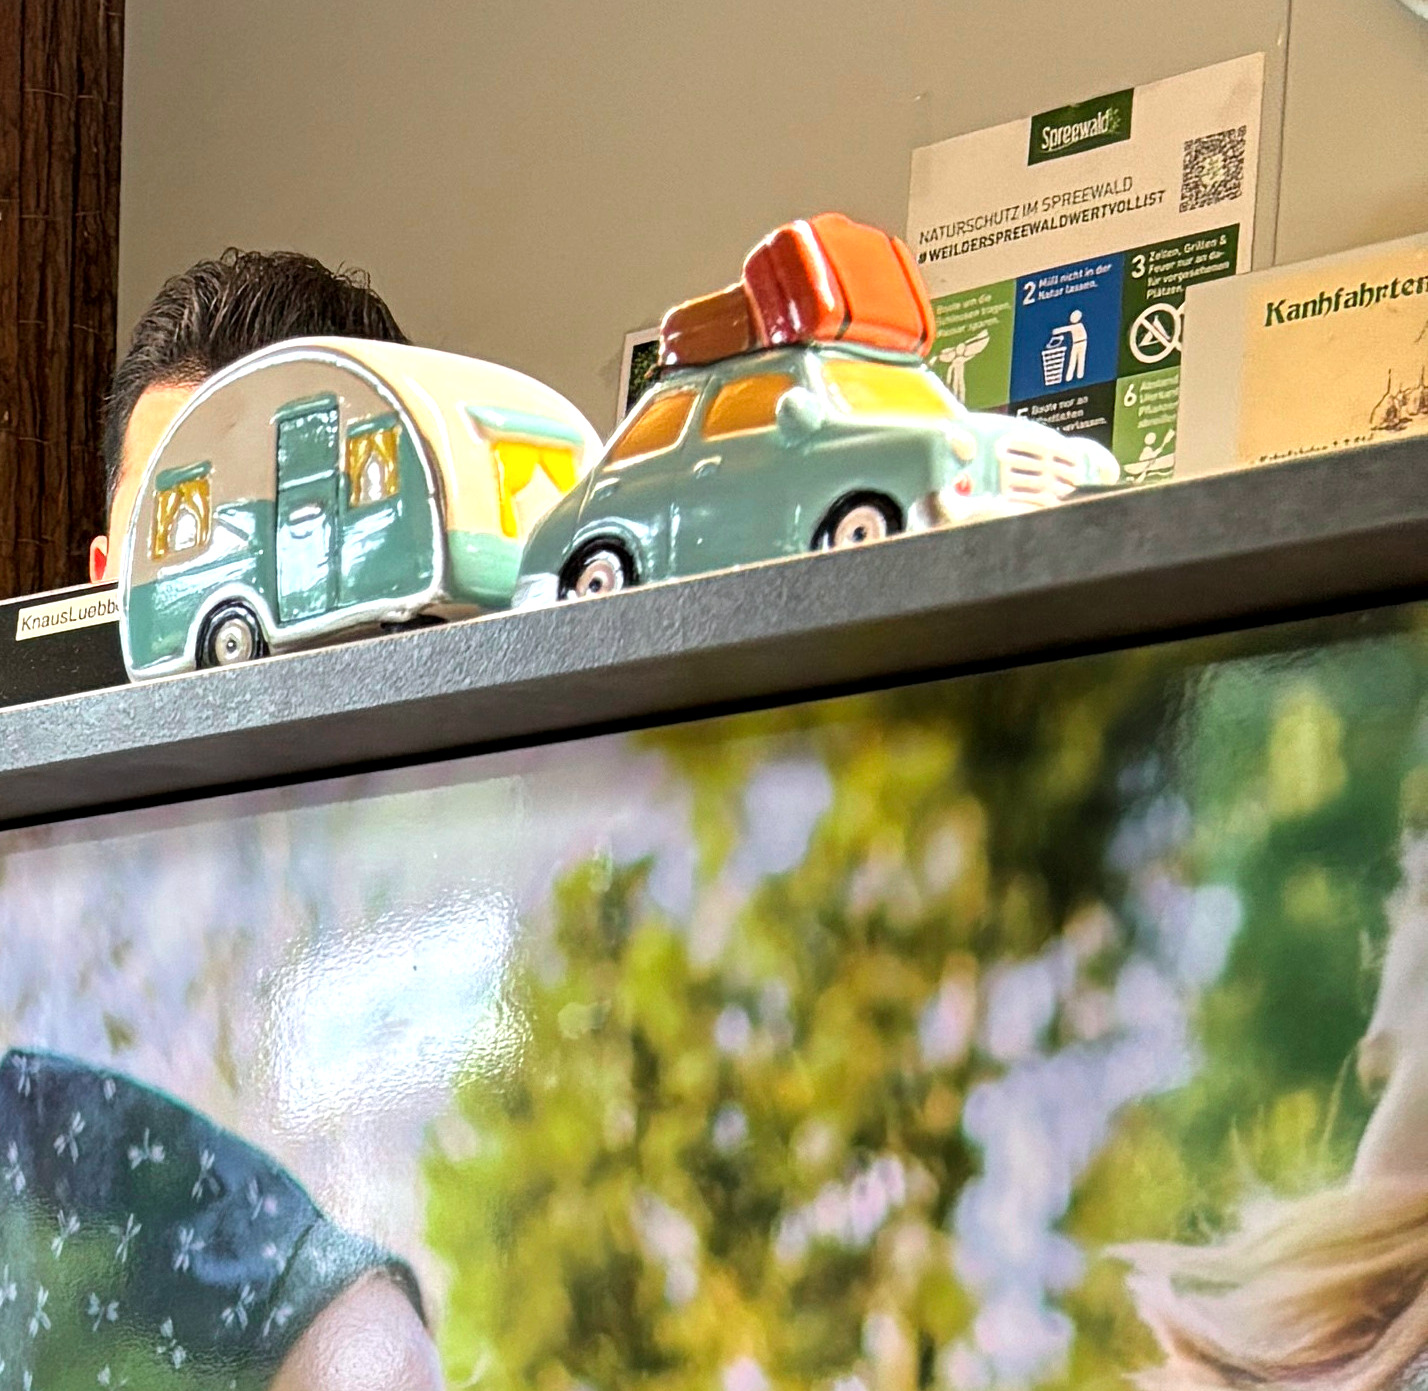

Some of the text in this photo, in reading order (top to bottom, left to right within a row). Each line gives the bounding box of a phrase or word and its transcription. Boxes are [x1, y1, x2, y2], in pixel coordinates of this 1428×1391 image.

[1041, 108, 1110, 151] Spreewald
[918, 190, 1165, 264] #WEILDERSPREEWALDWERTVOLLIST
[919, 176, 1133, 244] NATURSCHUTZ IM SPREEWALD
[1132, 254, 1146, 279] 3
[1023, 281, 1036, 306] 2
[1124, 384, 1137, 406] 6
